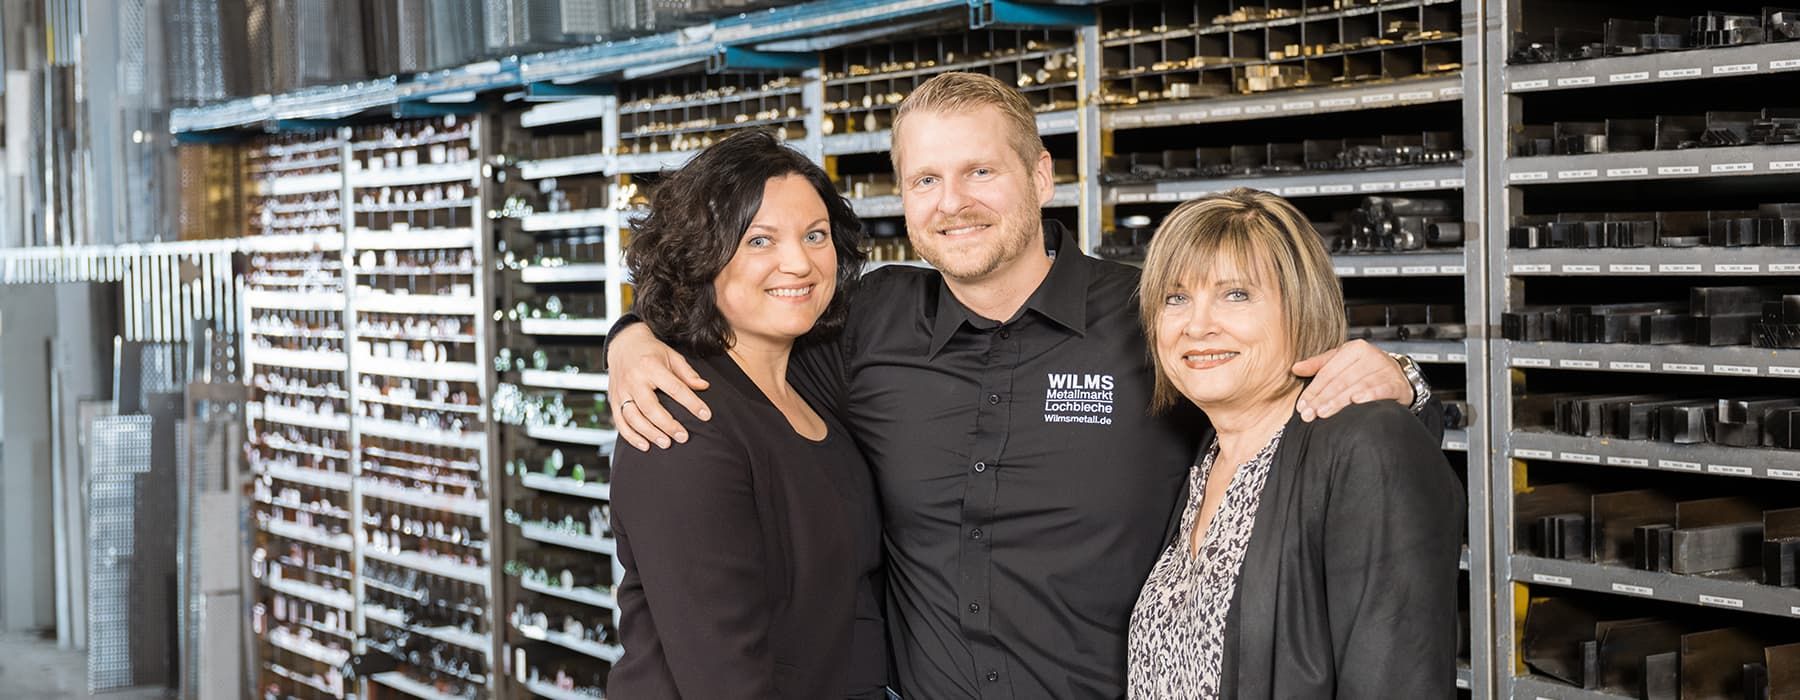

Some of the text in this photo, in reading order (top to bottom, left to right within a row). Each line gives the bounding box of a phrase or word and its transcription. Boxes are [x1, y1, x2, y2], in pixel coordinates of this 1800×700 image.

[1048, 374, 1114, 390] WILMS
[1047, 389, 1113, 400] Metallmarkt
[1045, 401, 1113, 413] Lochbleche
[1044, 414, 1112, 425] Wilmsmetall.de
